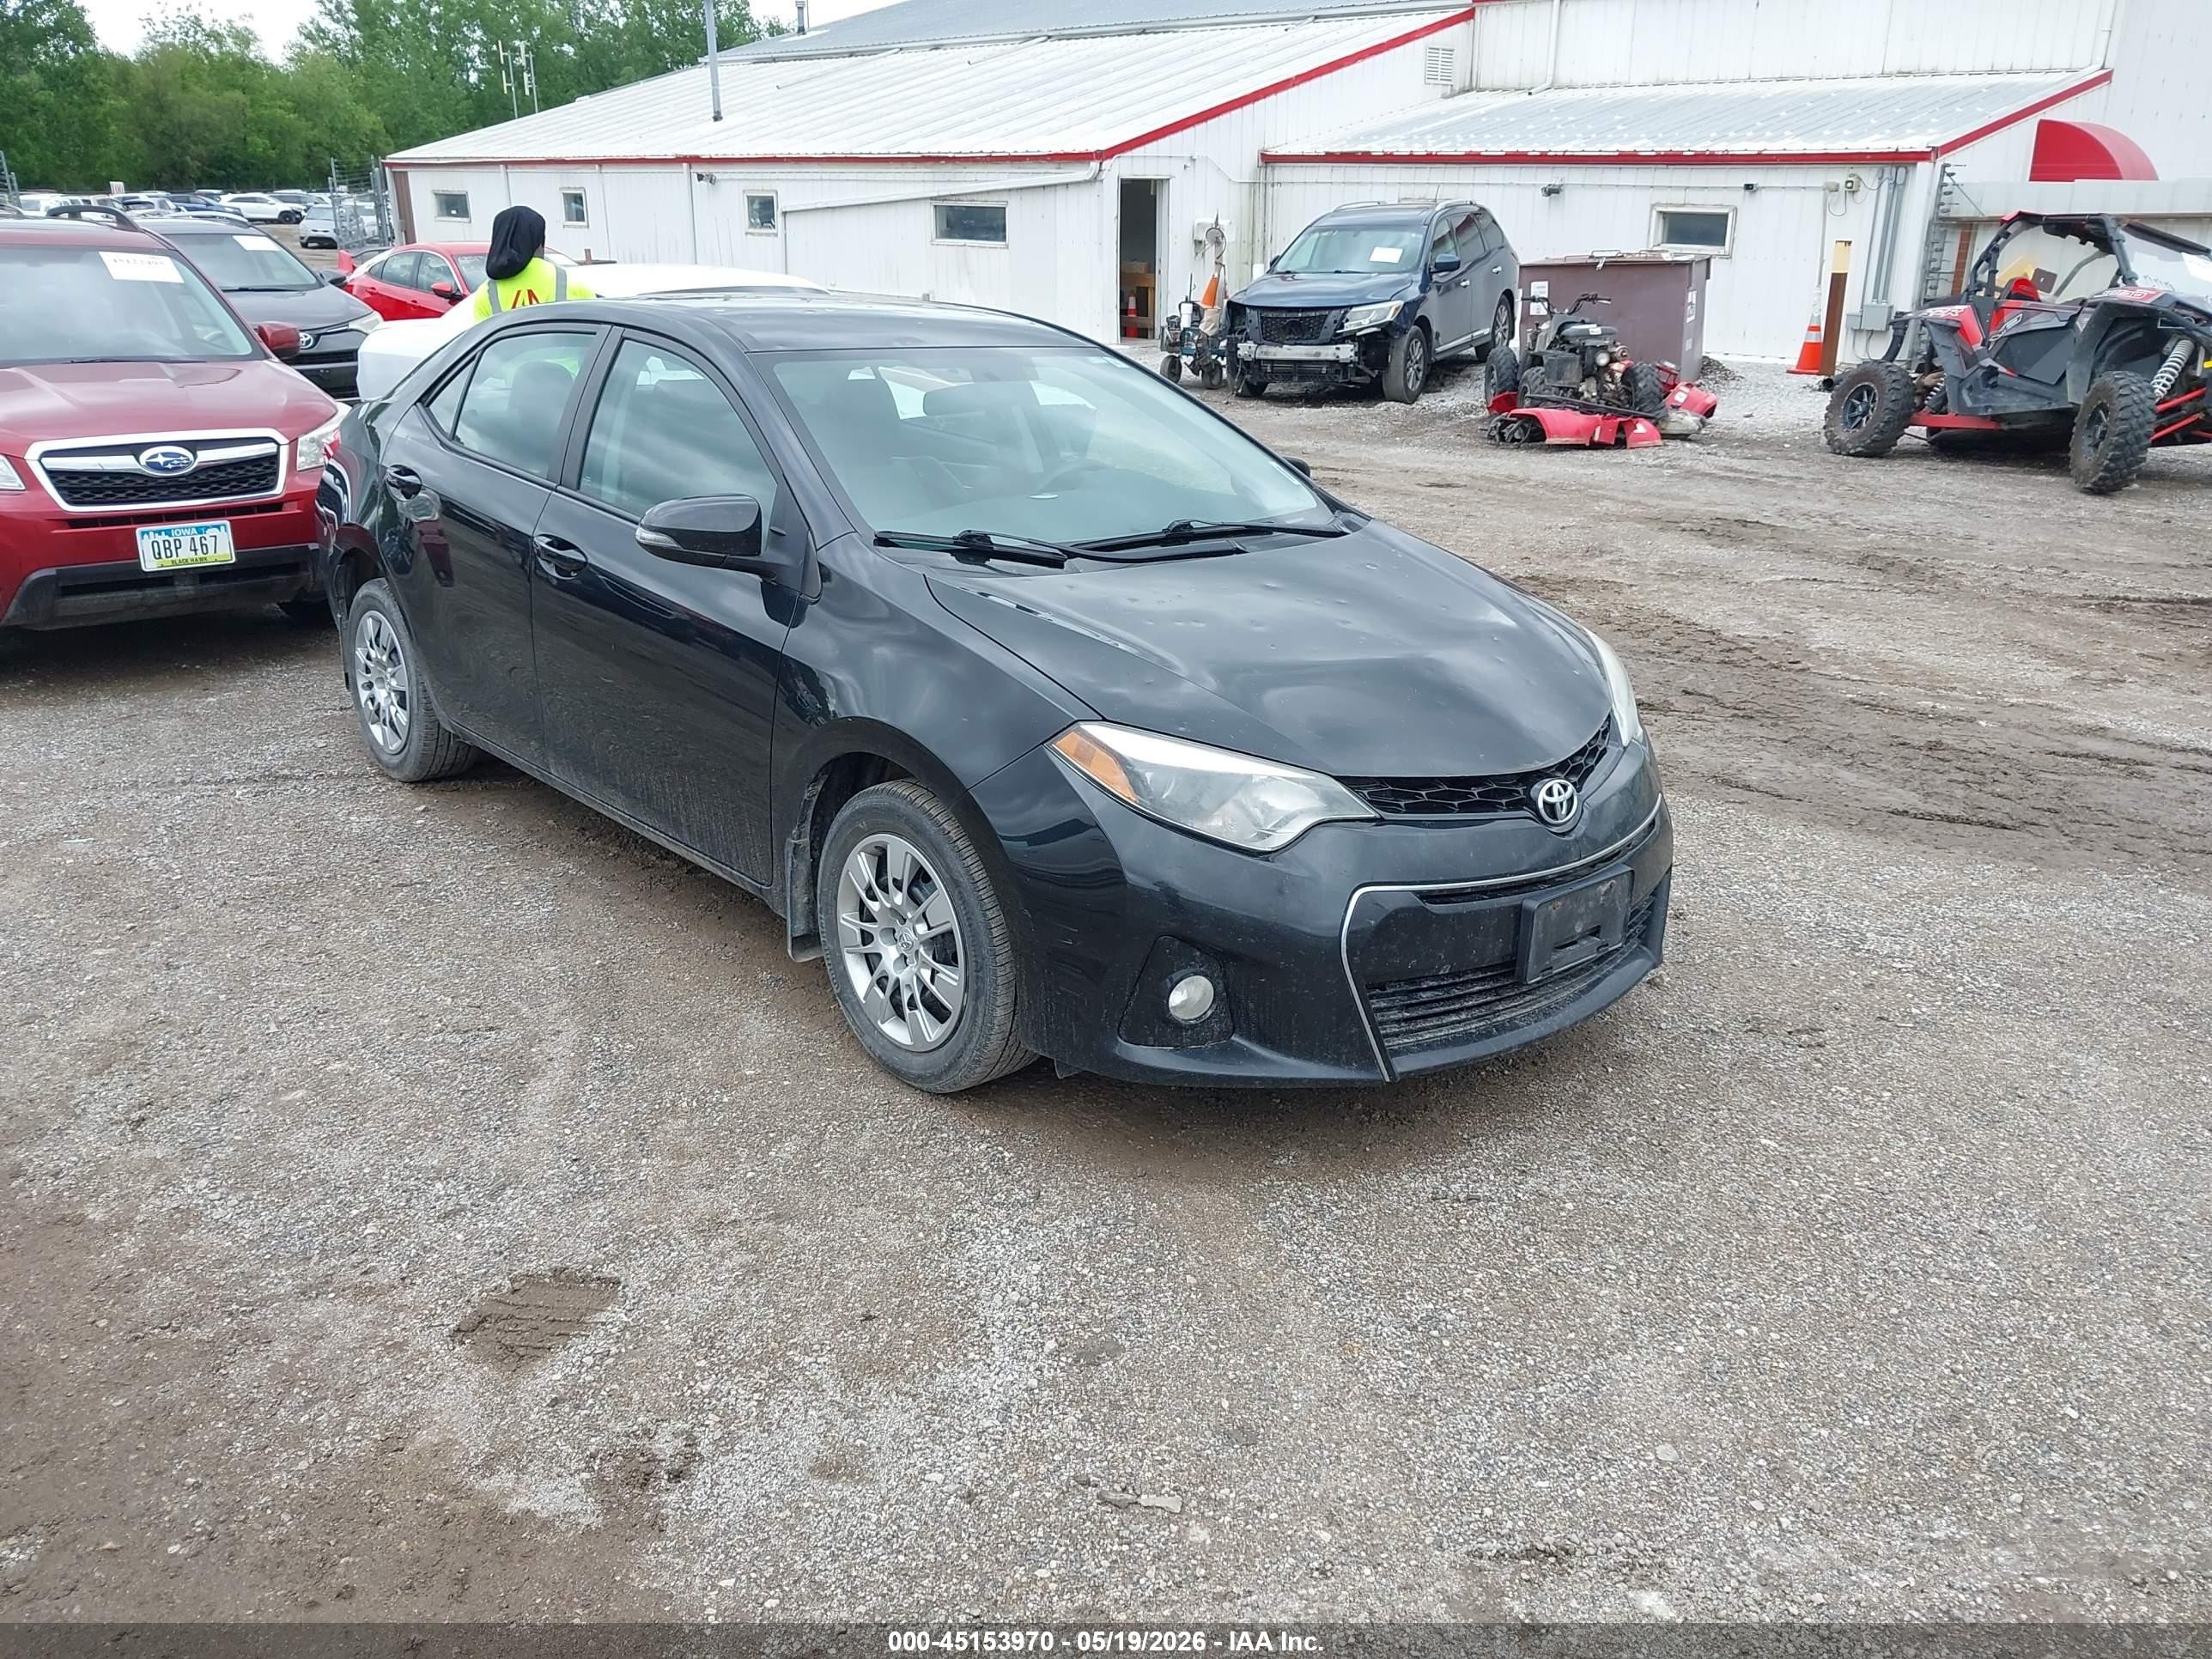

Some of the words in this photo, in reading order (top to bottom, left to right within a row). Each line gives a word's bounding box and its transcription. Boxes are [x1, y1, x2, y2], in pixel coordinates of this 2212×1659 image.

[171, 527, 198, 538] IOWA
[151, 538, 183, 560] QBP
[189, 534, 218, 556] 467
